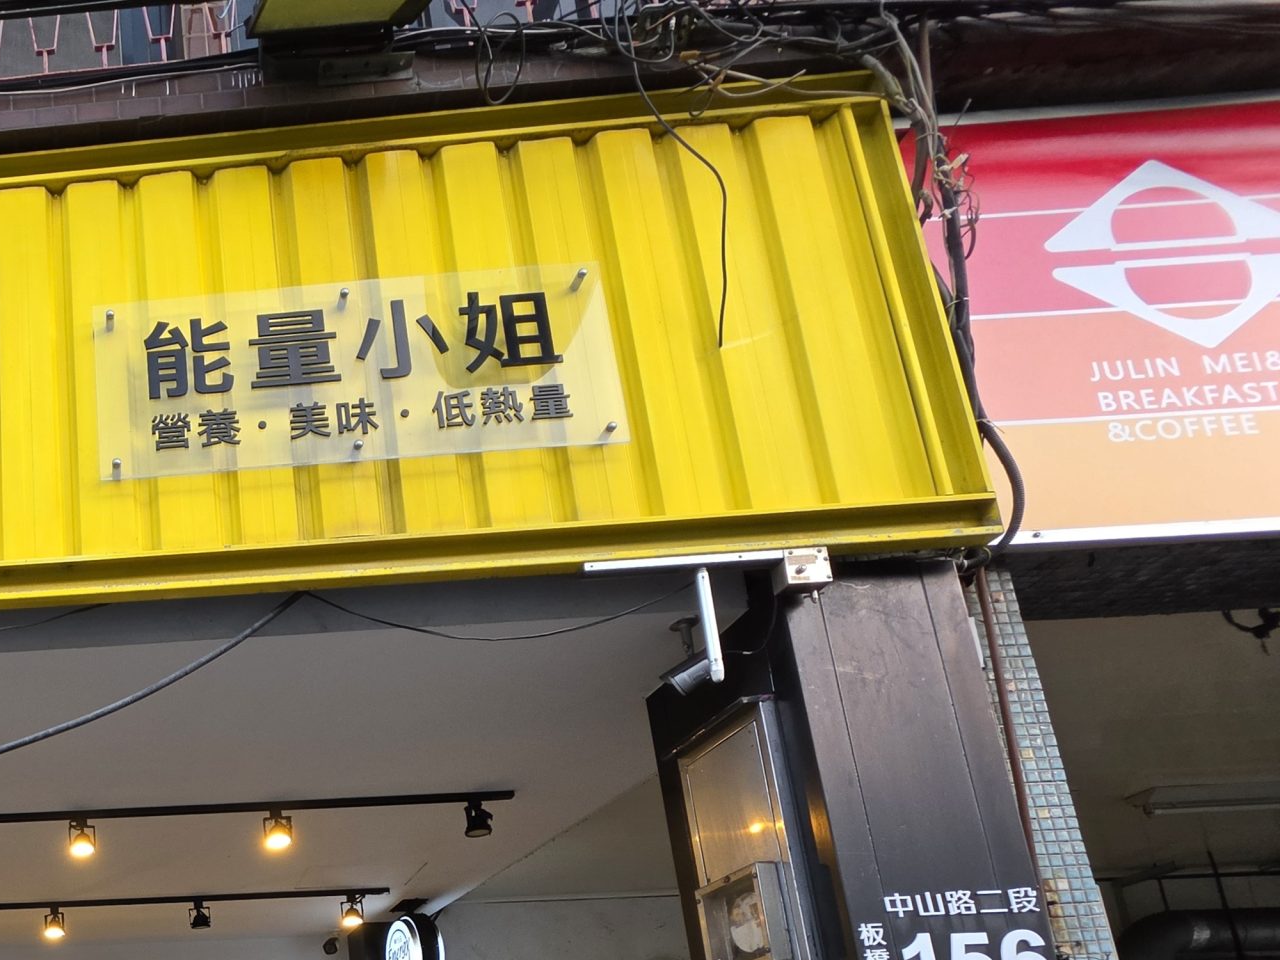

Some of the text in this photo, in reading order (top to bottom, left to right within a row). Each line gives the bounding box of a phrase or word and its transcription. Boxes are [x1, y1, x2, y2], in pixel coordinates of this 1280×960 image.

[143, 291, 564, 400] 能量小姐
[1090, 357, 1181, 382] JULIN
[1097, 381, 1279, 412] BREAKFAST
[1108, 414, 1260, 442] &COFFEE
[883, 887, 1041, 918] 中山路二段
